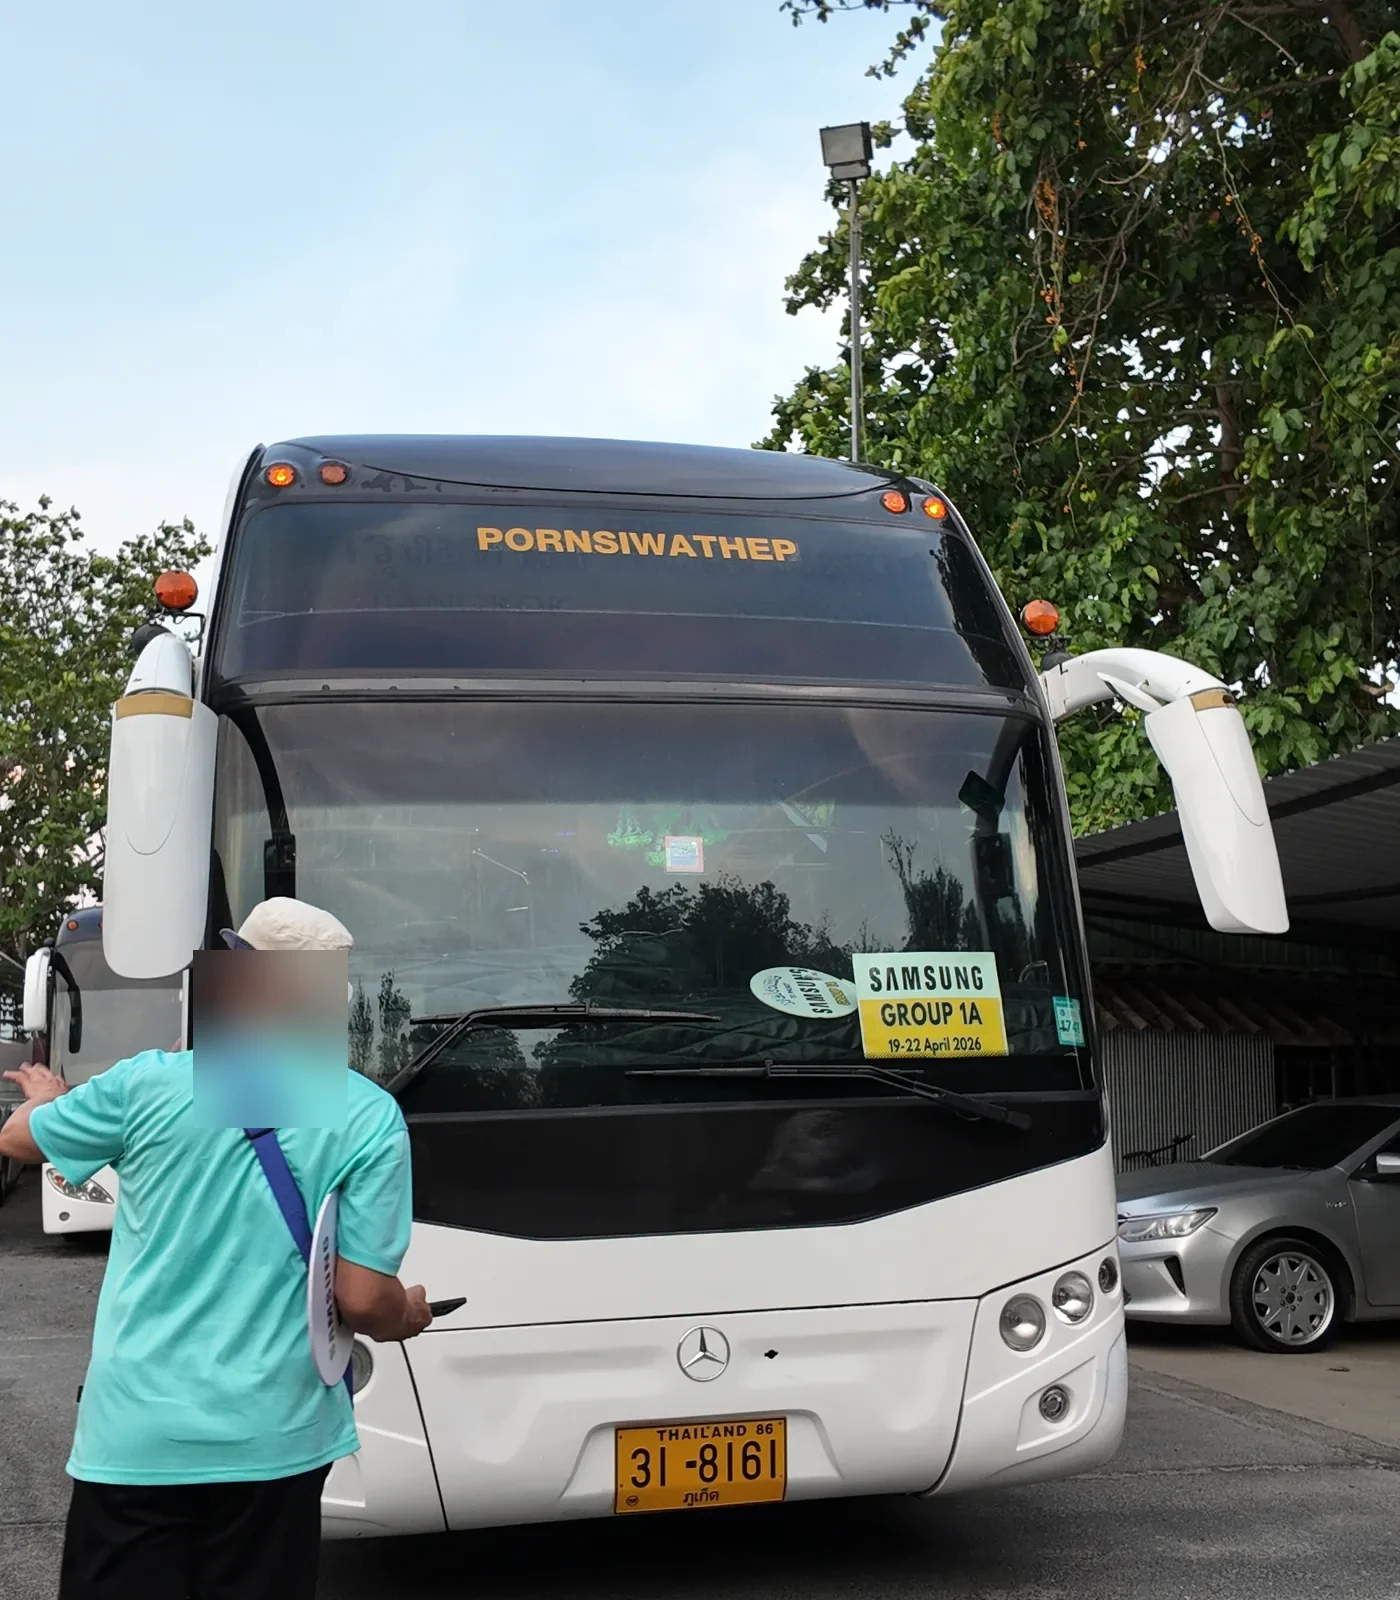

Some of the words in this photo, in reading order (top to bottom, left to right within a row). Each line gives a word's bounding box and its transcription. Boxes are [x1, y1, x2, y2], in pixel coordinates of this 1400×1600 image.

[476, 526, 797, 563] PORNSIWATHEP
[789, 968, 833, 1014] SAMSUNG
[869, 965, 984, 992] SAMSUNG
[881, 1002, 953, 1027] GROUP
[959, 1002, 983, 1025] 1A
[888, 1038, 922, 1053] 19-22
[924, 1037, 951, 1055] April
[953, 1037, 982, 1051] 2026
[656, 1424, 747, 1442] THAILAND
[755, 1423, 774, 1436] 86
